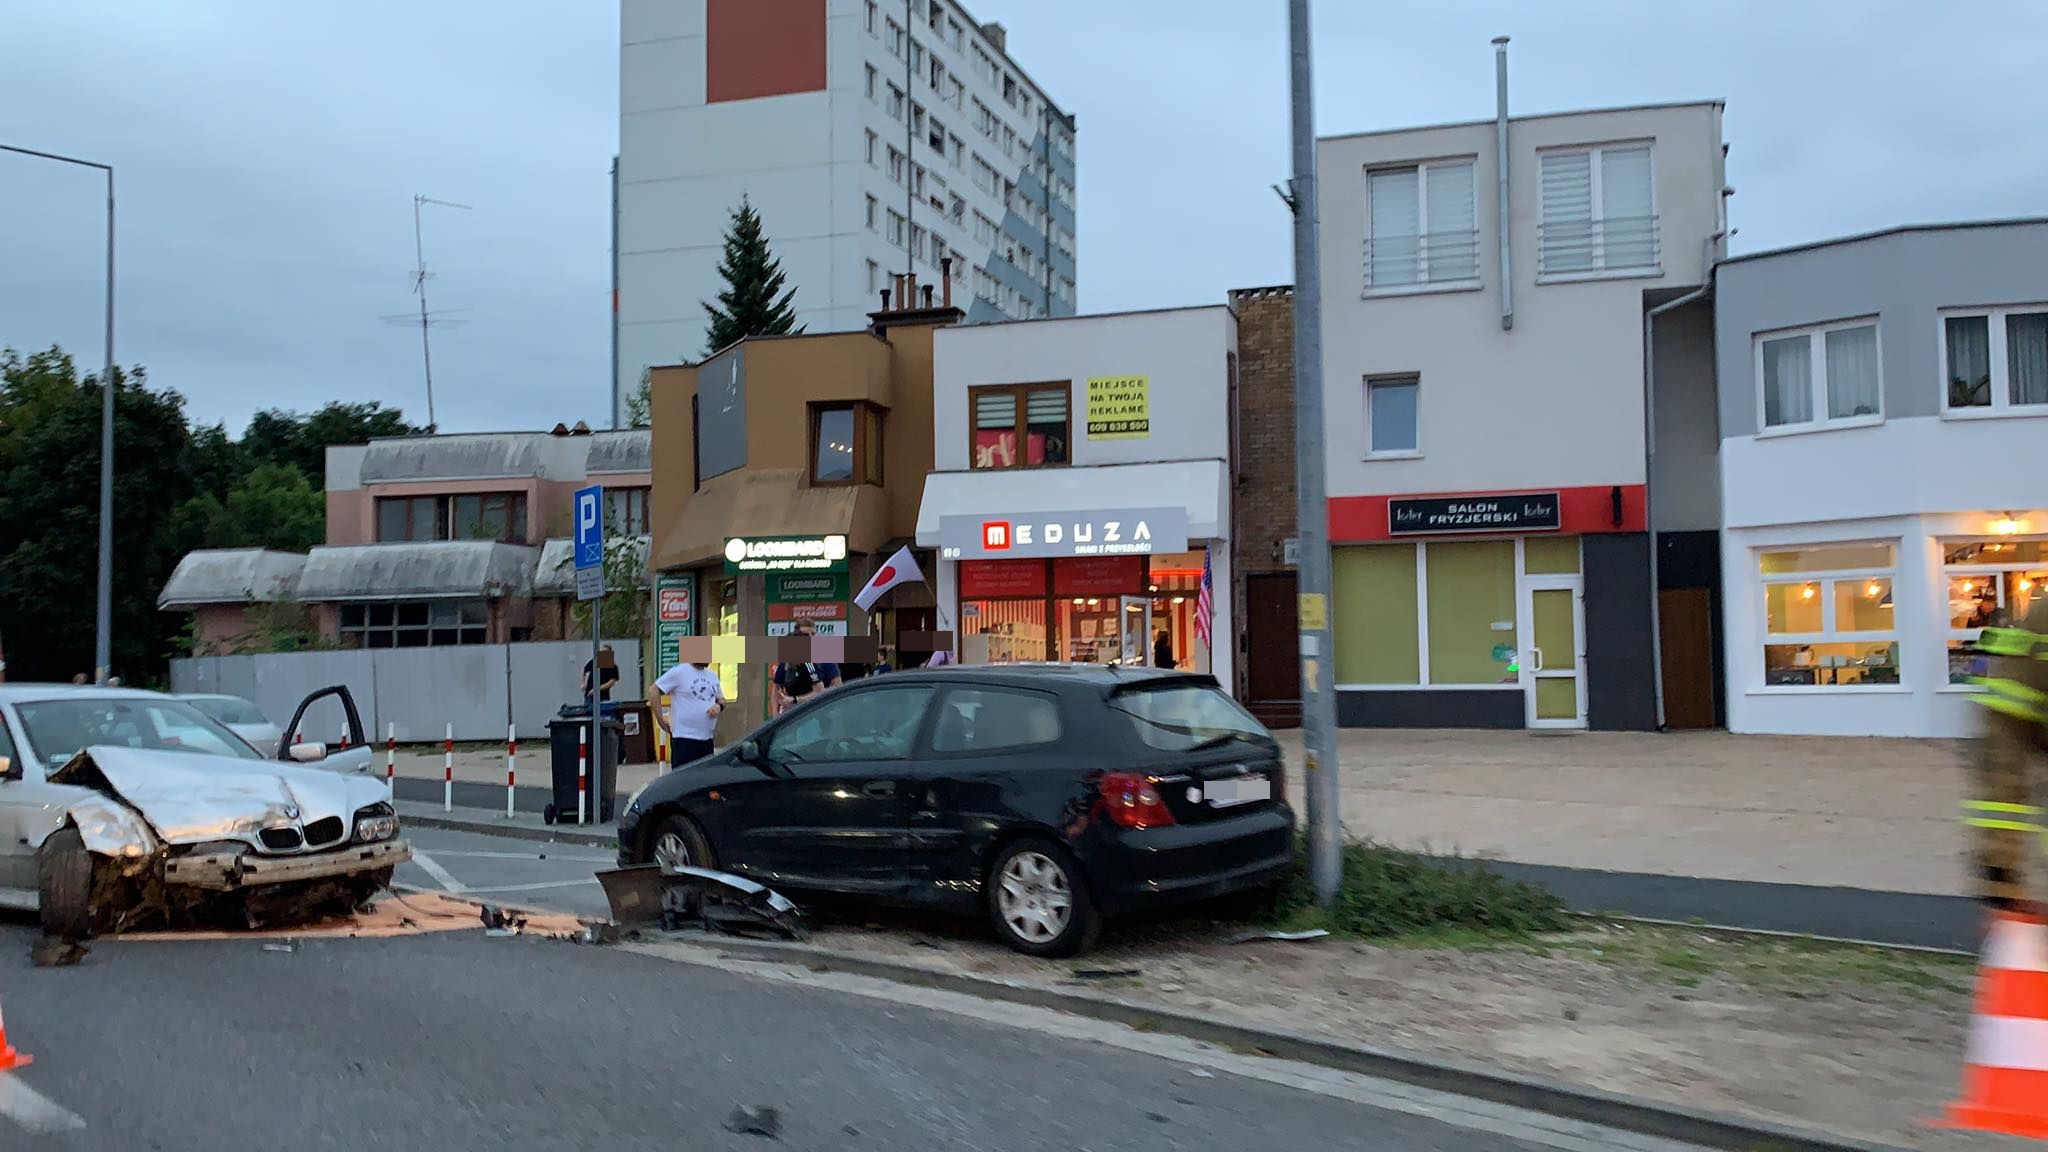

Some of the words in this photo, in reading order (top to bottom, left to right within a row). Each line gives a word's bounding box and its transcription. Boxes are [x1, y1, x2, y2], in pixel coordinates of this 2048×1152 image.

[1090, 380, 1144, 390] MIEJSCE
[1090, 394, 1104, 403] NA
[1448, 502, 1498, 514] SALON
[580, 494, 596, 545] P
[1429, 512, 1518, 525] FRYZJERSKI
[986, 521, 1152, 546] MEDUZA
[783, 579, 831, 590] LOOMBARD
